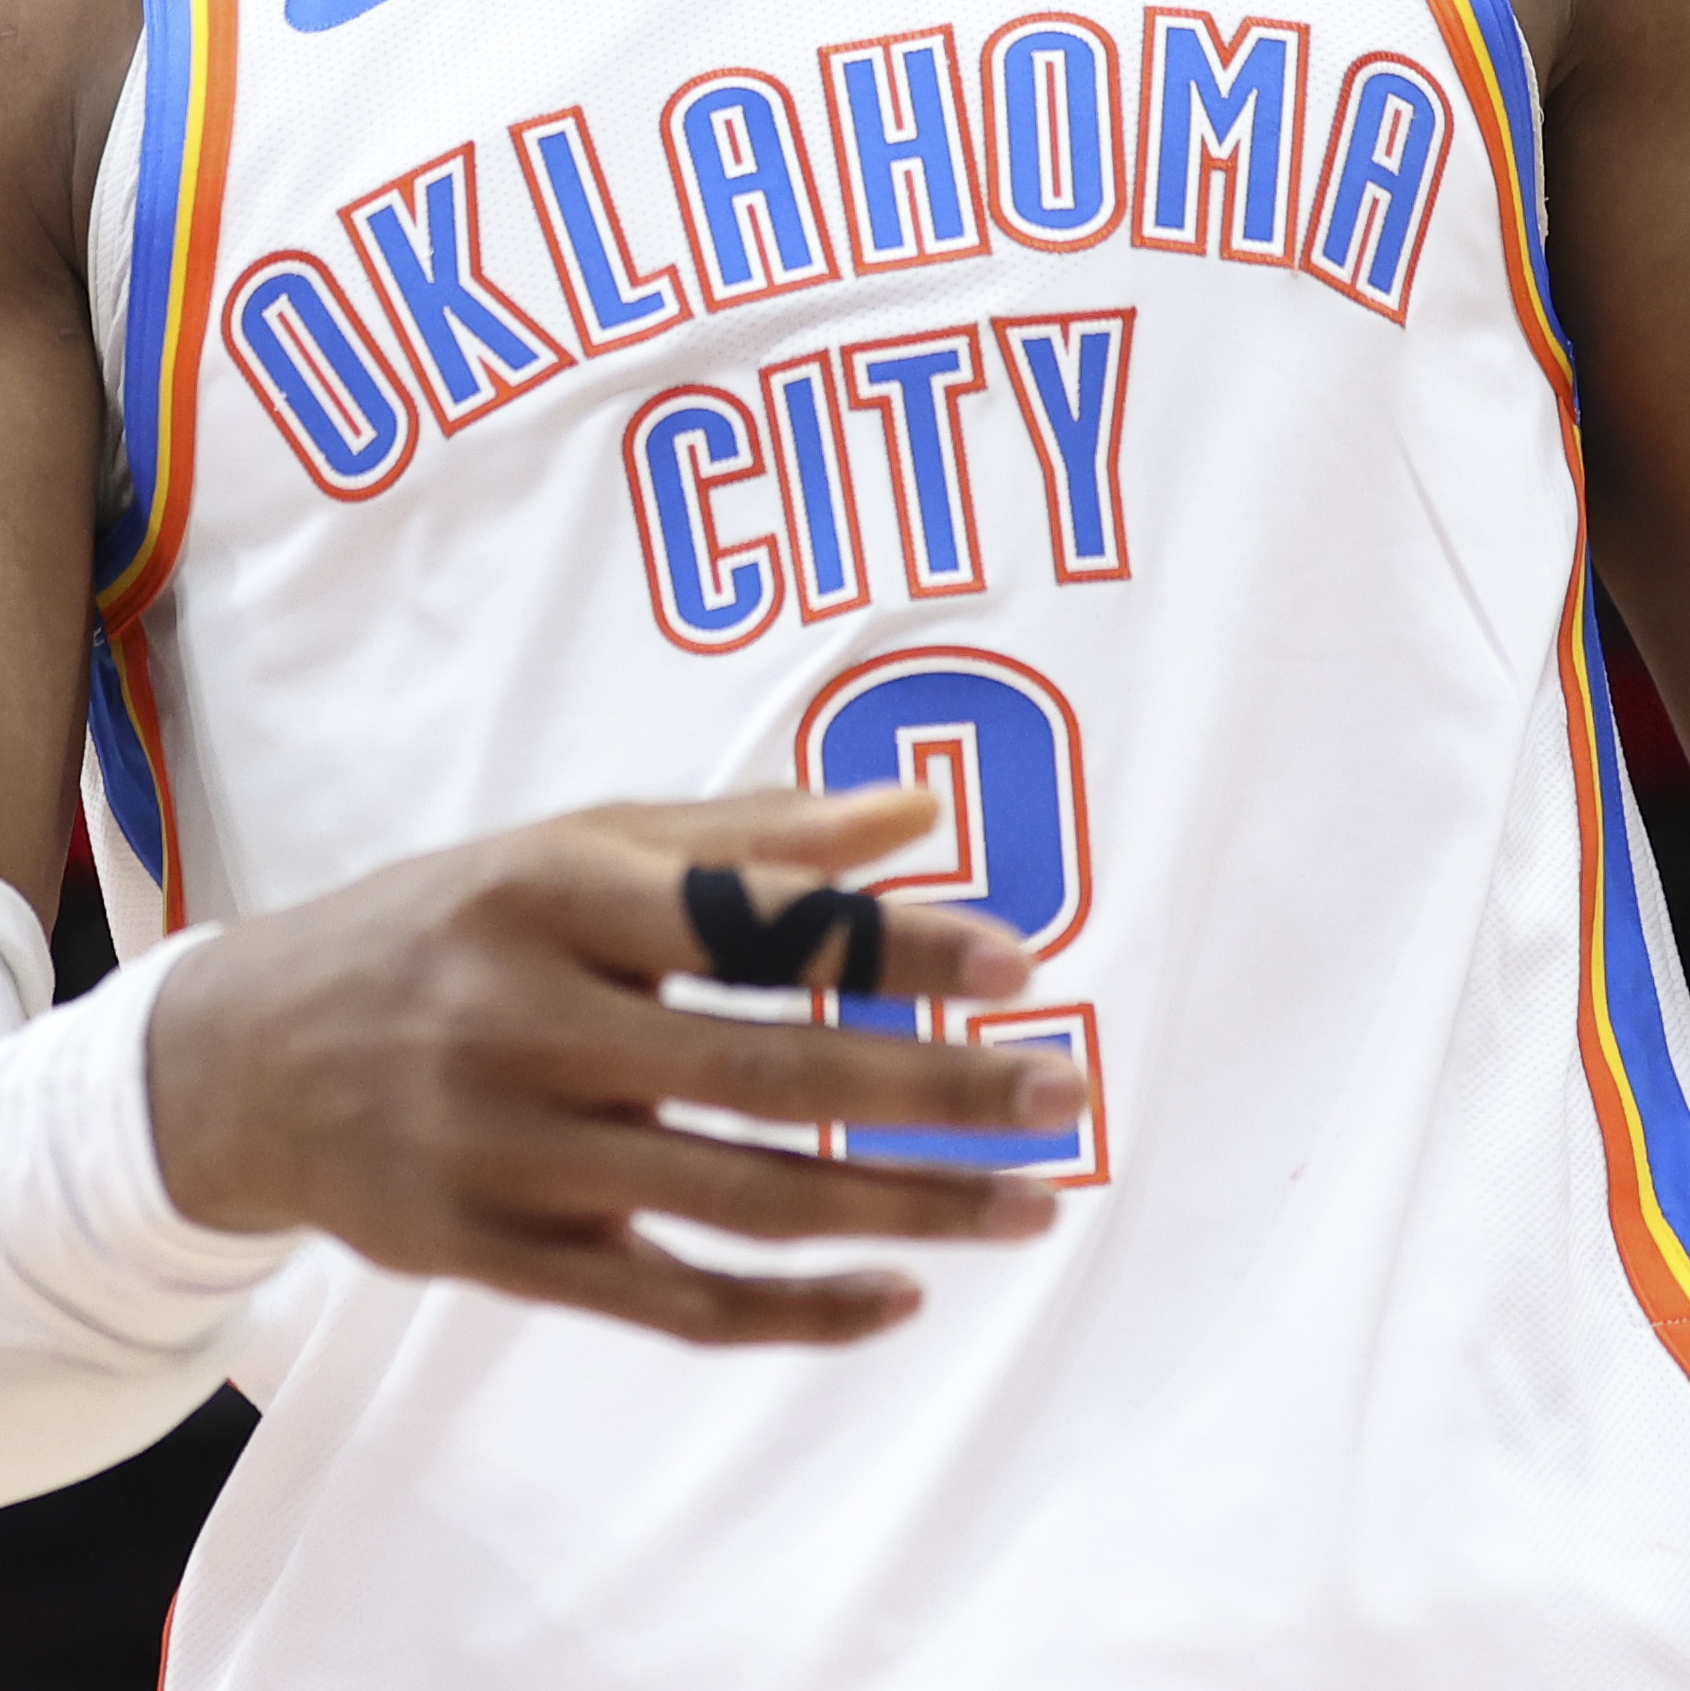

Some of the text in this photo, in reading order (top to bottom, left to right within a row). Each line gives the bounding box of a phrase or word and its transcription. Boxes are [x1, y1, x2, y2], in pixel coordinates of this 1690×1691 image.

[221, 6, 1454, 502] OKLAHOMA
[622, 307, 1137, 656] CITY
[794, 645, 1111, 1189] 2
